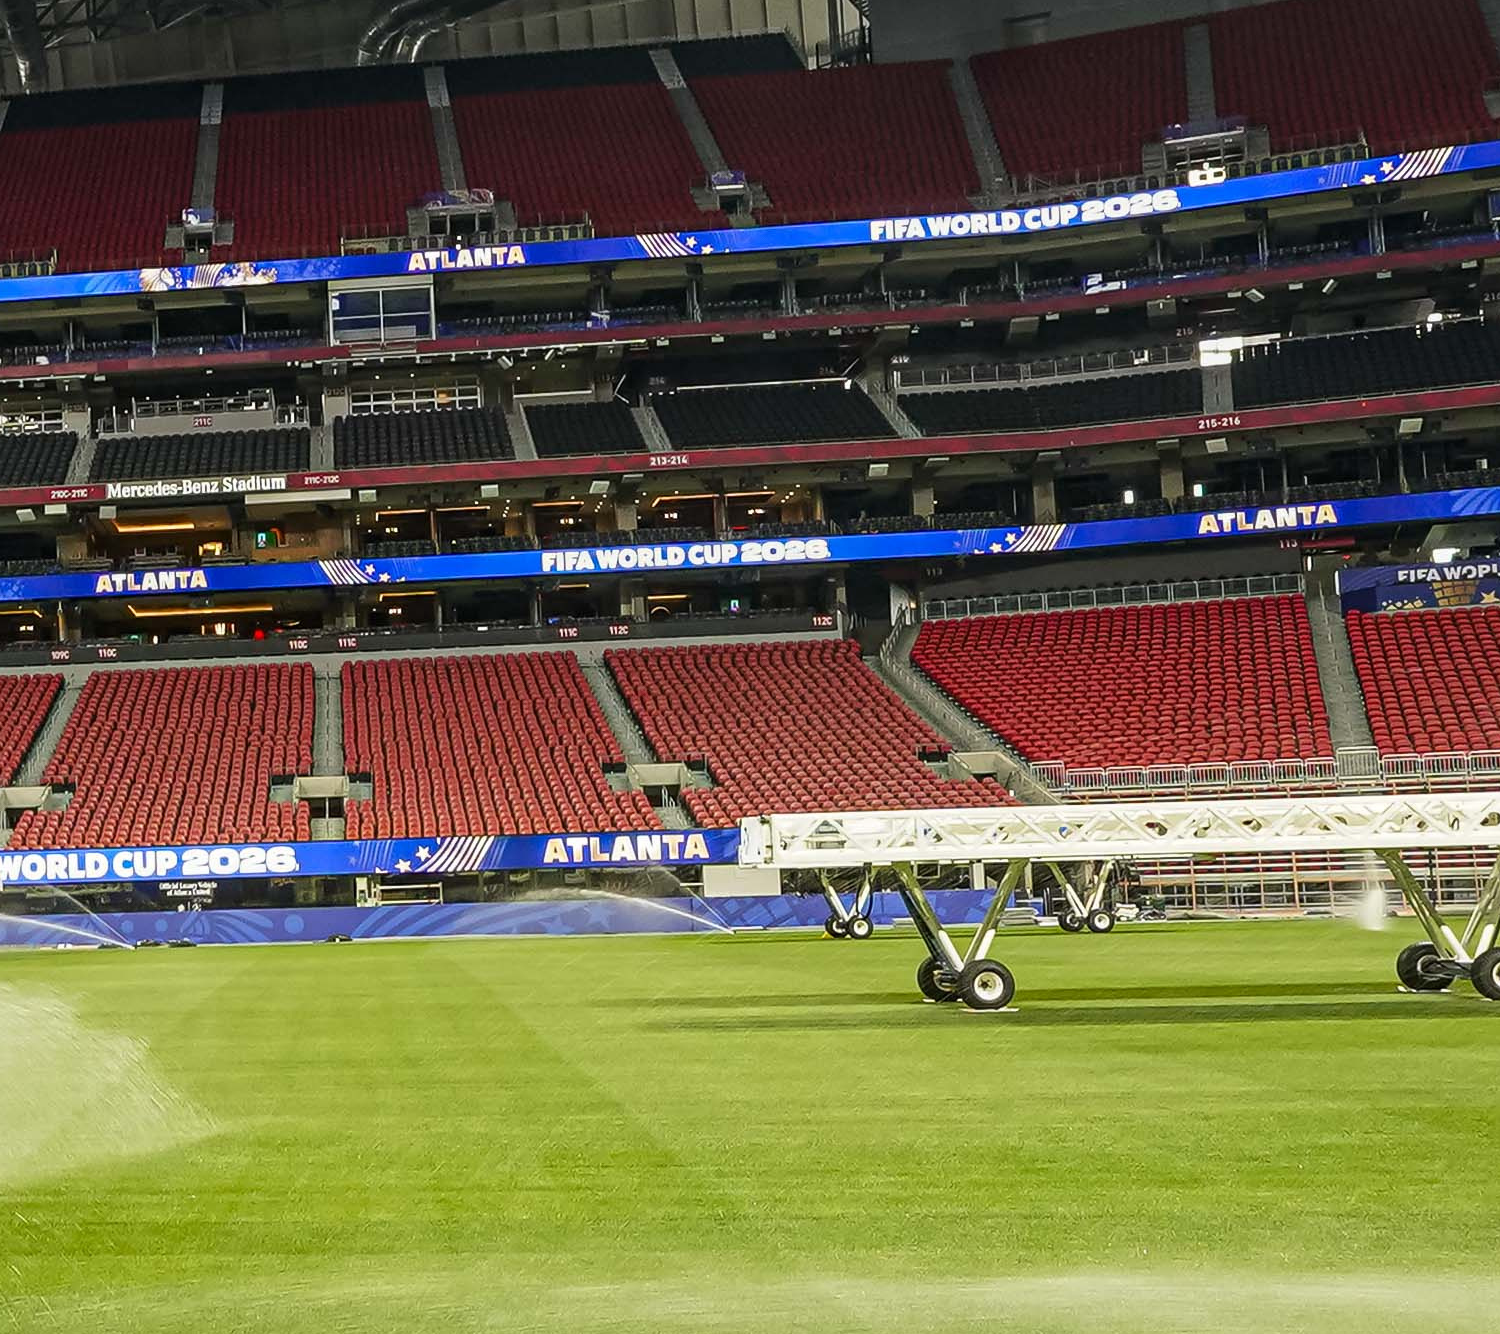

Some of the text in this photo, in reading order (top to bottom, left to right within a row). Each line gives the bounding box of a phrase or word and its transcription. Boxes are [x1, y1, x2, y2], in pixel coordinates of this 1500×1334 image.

[870, 189, 1181, 241] FIFA WORLD CUP 2026
[408, 246, 526, 271] ATLANTA
[193, 417, 212, 426] 211C
[1198, 417, 1241, 429] 215-216
[650, 455, 688, 466] 213-214
[107, 475, 286, 498] Mercedes-Benz Stadium
[1198, 503, 1338, 535] ATLANTA
[1279, 538, 1298, 549] 113
[542, 539, 831, 572] FIFA WORLD CUP 2026
[1397, 565, 1441, 582] FIFA
[95, 570, 208, 594] ATLANTA
[812, 616, 832, 626] 112C
[558, 627, 578, 637] 111C
[609, 625, 629, 635] 112C
[338, 637, 357, 648] 111C
[98, 648, 117, 658] 110C
[543, 833, 710, 863] ATLANTA
[0, 851, 111, 881] WORLD
[112, 849, 178, 877] CUP
[180, 846, 300, 875] 2026
